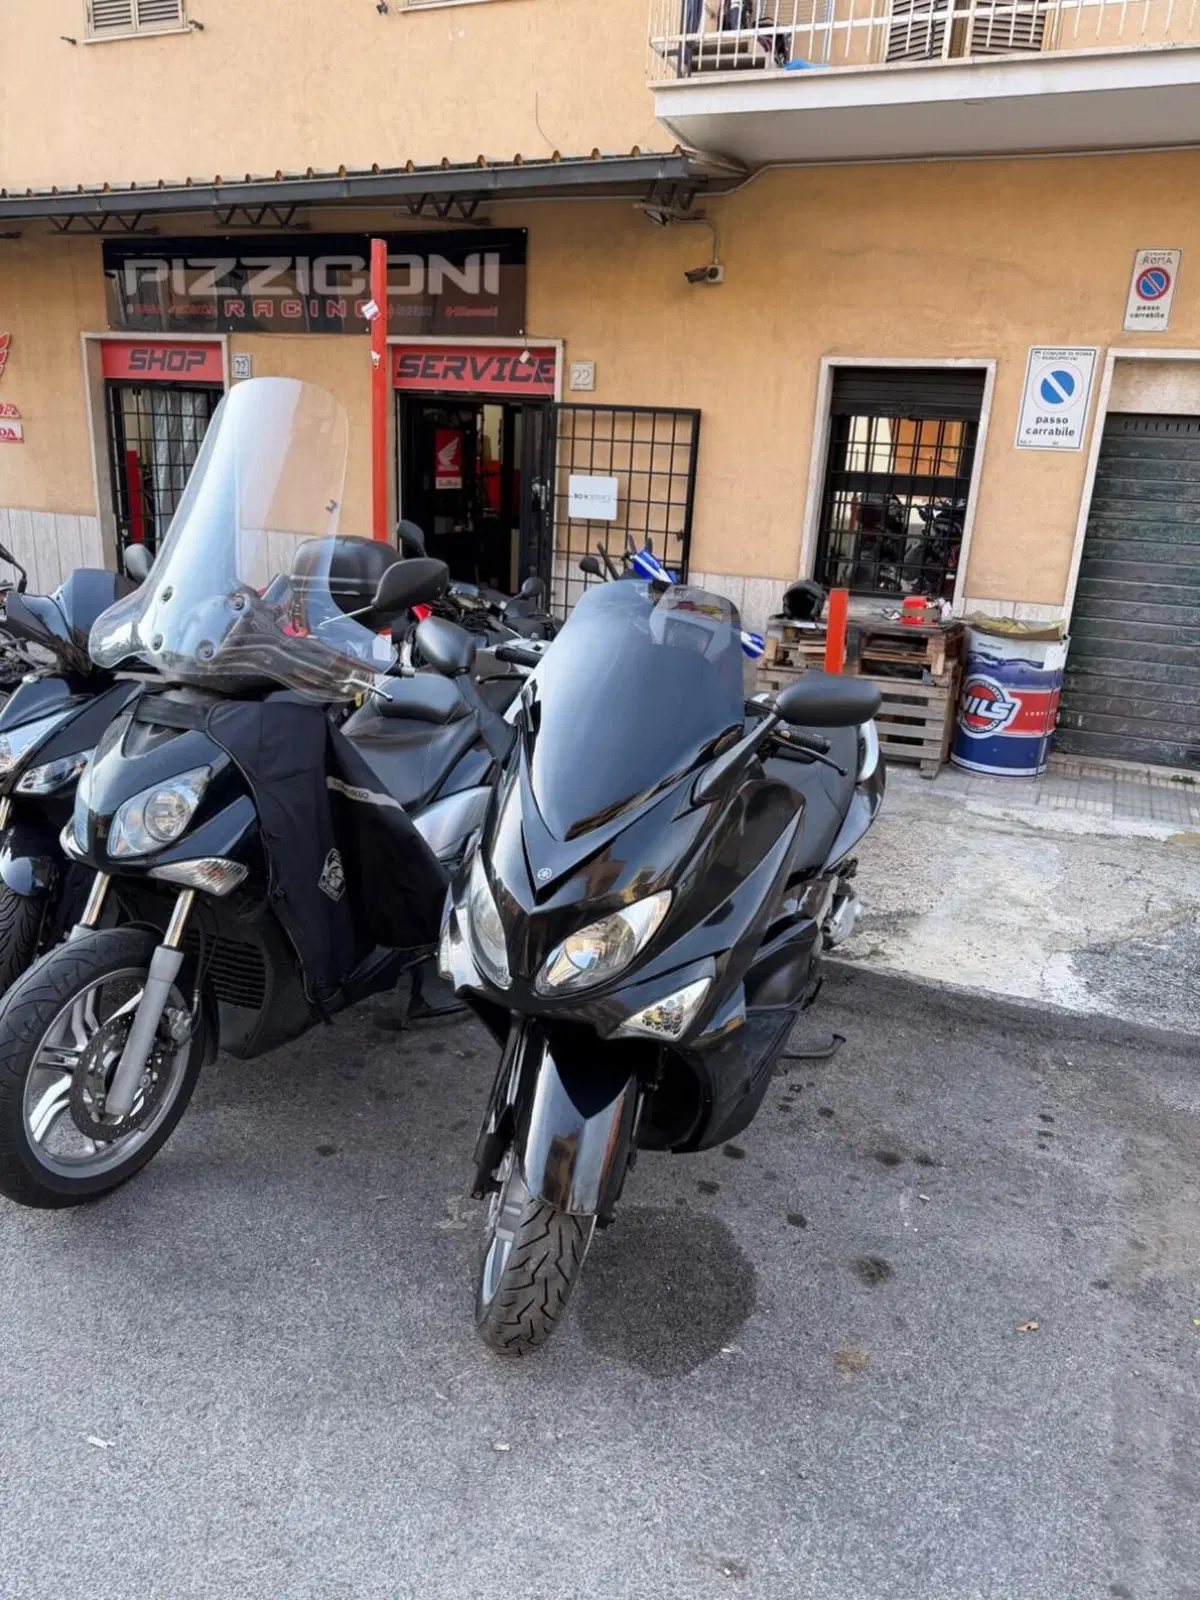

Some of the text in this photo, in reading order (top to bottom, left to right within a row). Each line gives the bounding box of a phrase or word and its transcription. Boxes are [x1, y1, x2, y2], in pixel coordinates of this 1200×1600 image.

[1142, 256, 1173, 265] ROMA
[128, 348, 207, 372] SHOP
[396, 353, 556, 383] SERVICE
[572, 368, 591, 386] 22
[1035, 415, 1069, 425] passo
[1025, 426, 1075, 437] carrabile
